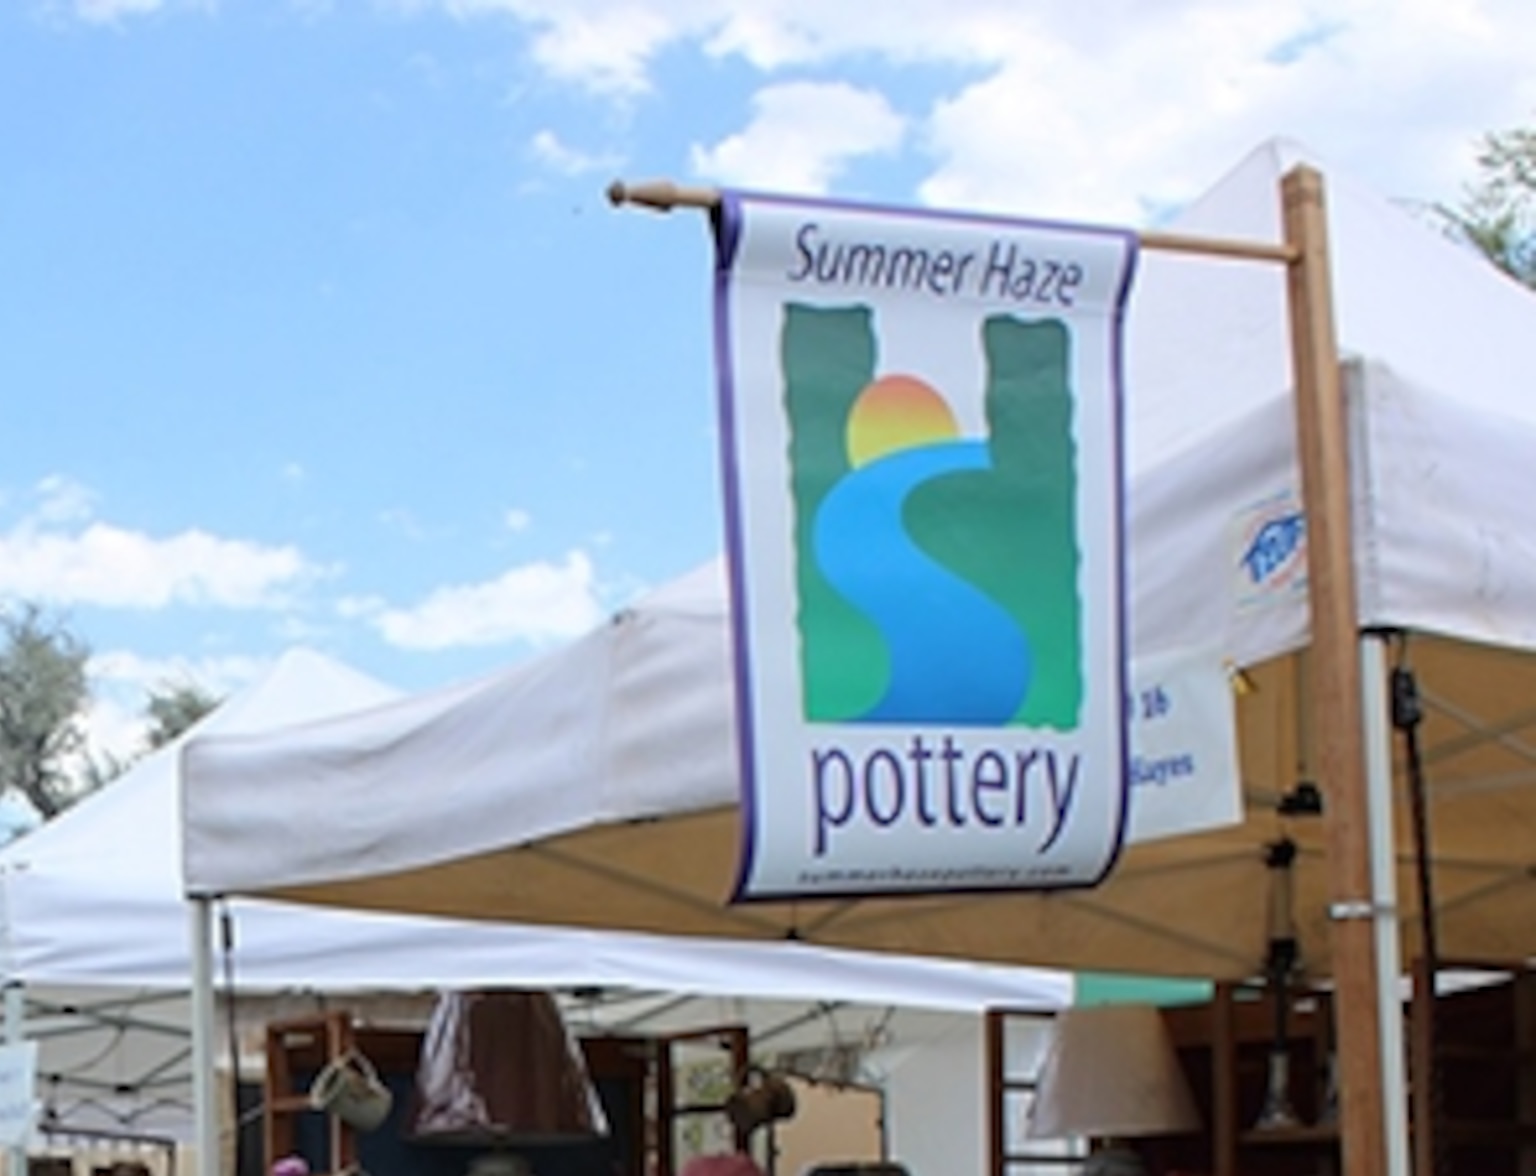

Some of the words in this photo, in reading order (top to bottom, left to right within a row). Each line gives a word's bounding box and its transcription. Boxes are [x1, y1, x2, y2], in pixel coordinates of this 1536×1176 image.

[787, 223, 974, 296] Summer
[980, 239, 1083, 308] Haze
[811, 736, 1080, 857] pottery
